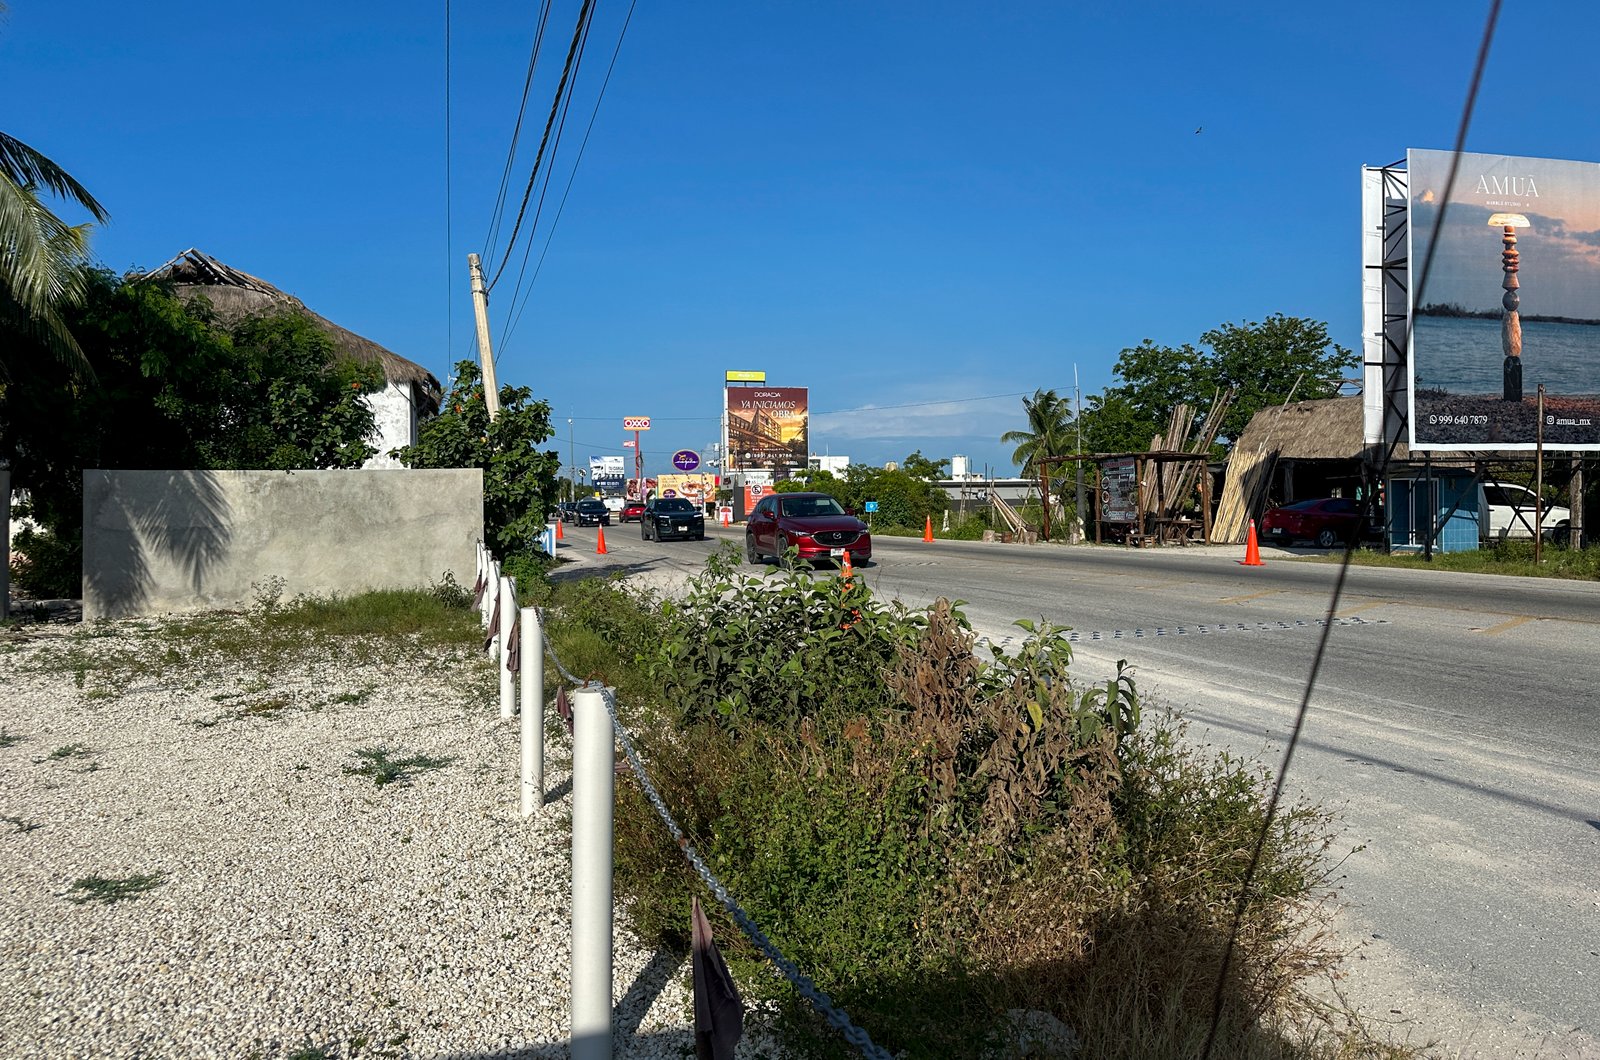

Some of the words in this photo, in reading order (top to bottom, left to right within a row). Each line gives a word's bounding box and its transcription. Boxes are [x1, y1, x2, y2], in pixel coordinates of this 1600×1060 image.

[740, 400, 751, 409] YA
[752, 400, 796, 409] INICIAMOS
[771, 410, 795, 418] OBRA
[624, 419, 650, 427] OXXO
[1438, 415, 1453, 425] 999
[1454, 415, 1468, 425] 640
[1470, 415, 1488, 425] 7879
[1556, 417, 1591, 426] amua_mx
